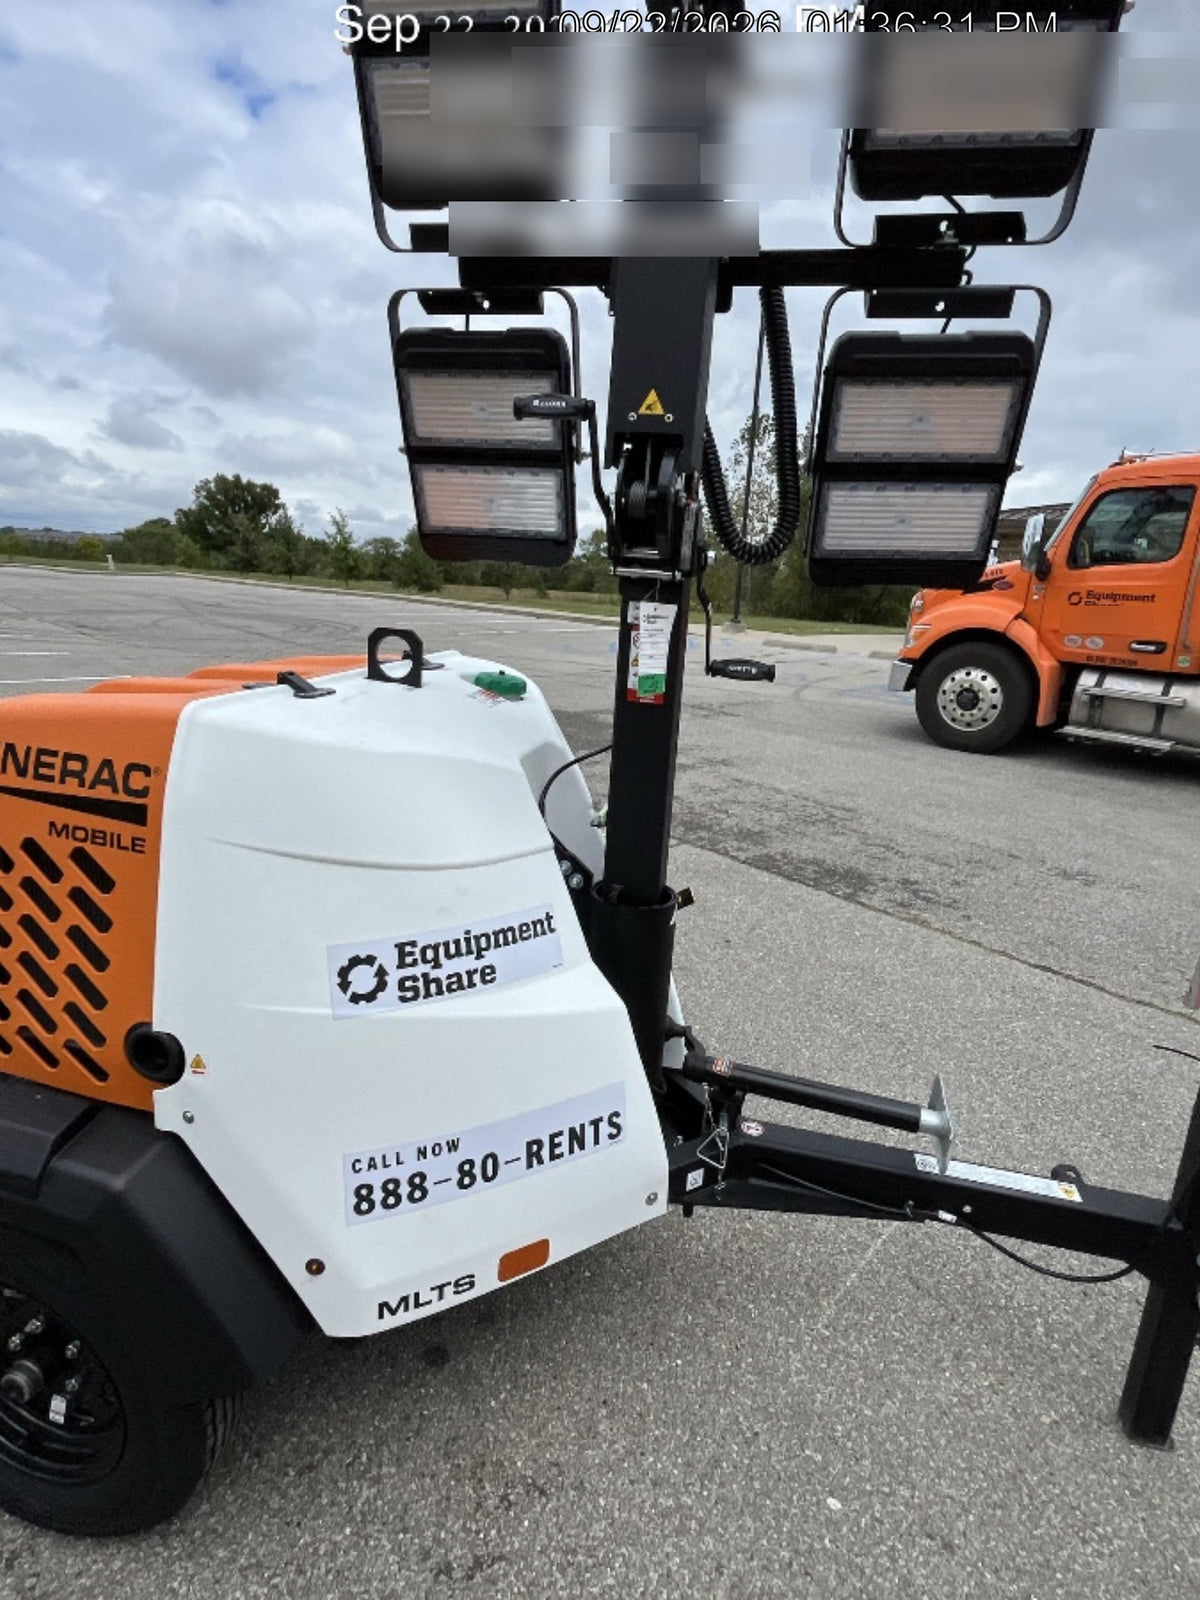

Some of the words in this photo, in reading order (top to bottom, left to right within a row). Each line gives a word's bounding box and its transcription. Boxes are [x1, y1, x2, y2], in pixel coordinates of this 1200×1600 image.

[1085, 590, 1156, 603] Equipment
[0, 742, 152, 799] NERAC
[48, 821, 147, 854] MOBILE
[394, 911, 557, 971] Equipment
[397, 963, 498, 1004] Share
[351, 1151, 405, 1174] CALL
[416, 1137, 461, 1161] NOW
[352, 1110, 623, 1217] 888-80-RENTS
[377, 1273, 476, 1320] MLTS
